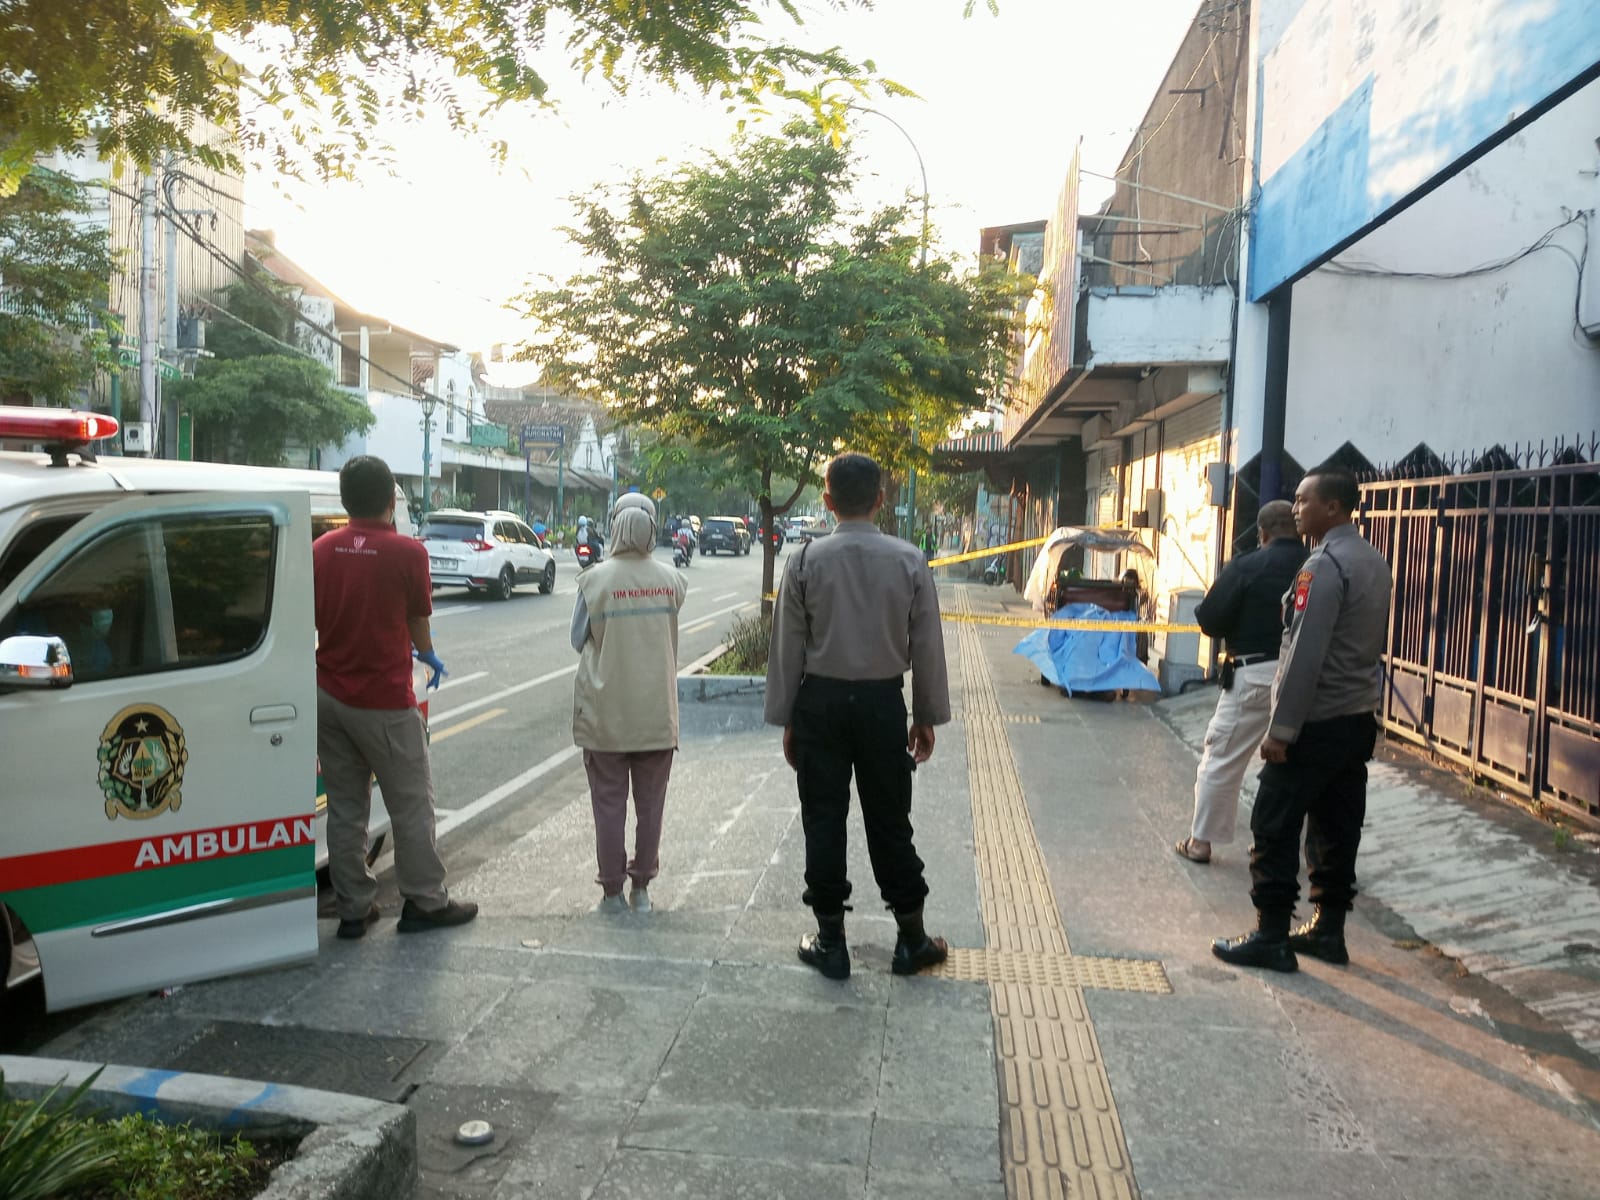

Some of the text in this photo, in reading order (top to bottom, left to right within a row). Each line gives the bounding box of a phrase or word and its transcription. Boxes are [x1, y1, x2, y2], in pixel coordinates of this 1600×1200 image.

[612, 586, 674, 600] TIM KESEHATAN
[134, 817, 316, 869] AMBULAN
